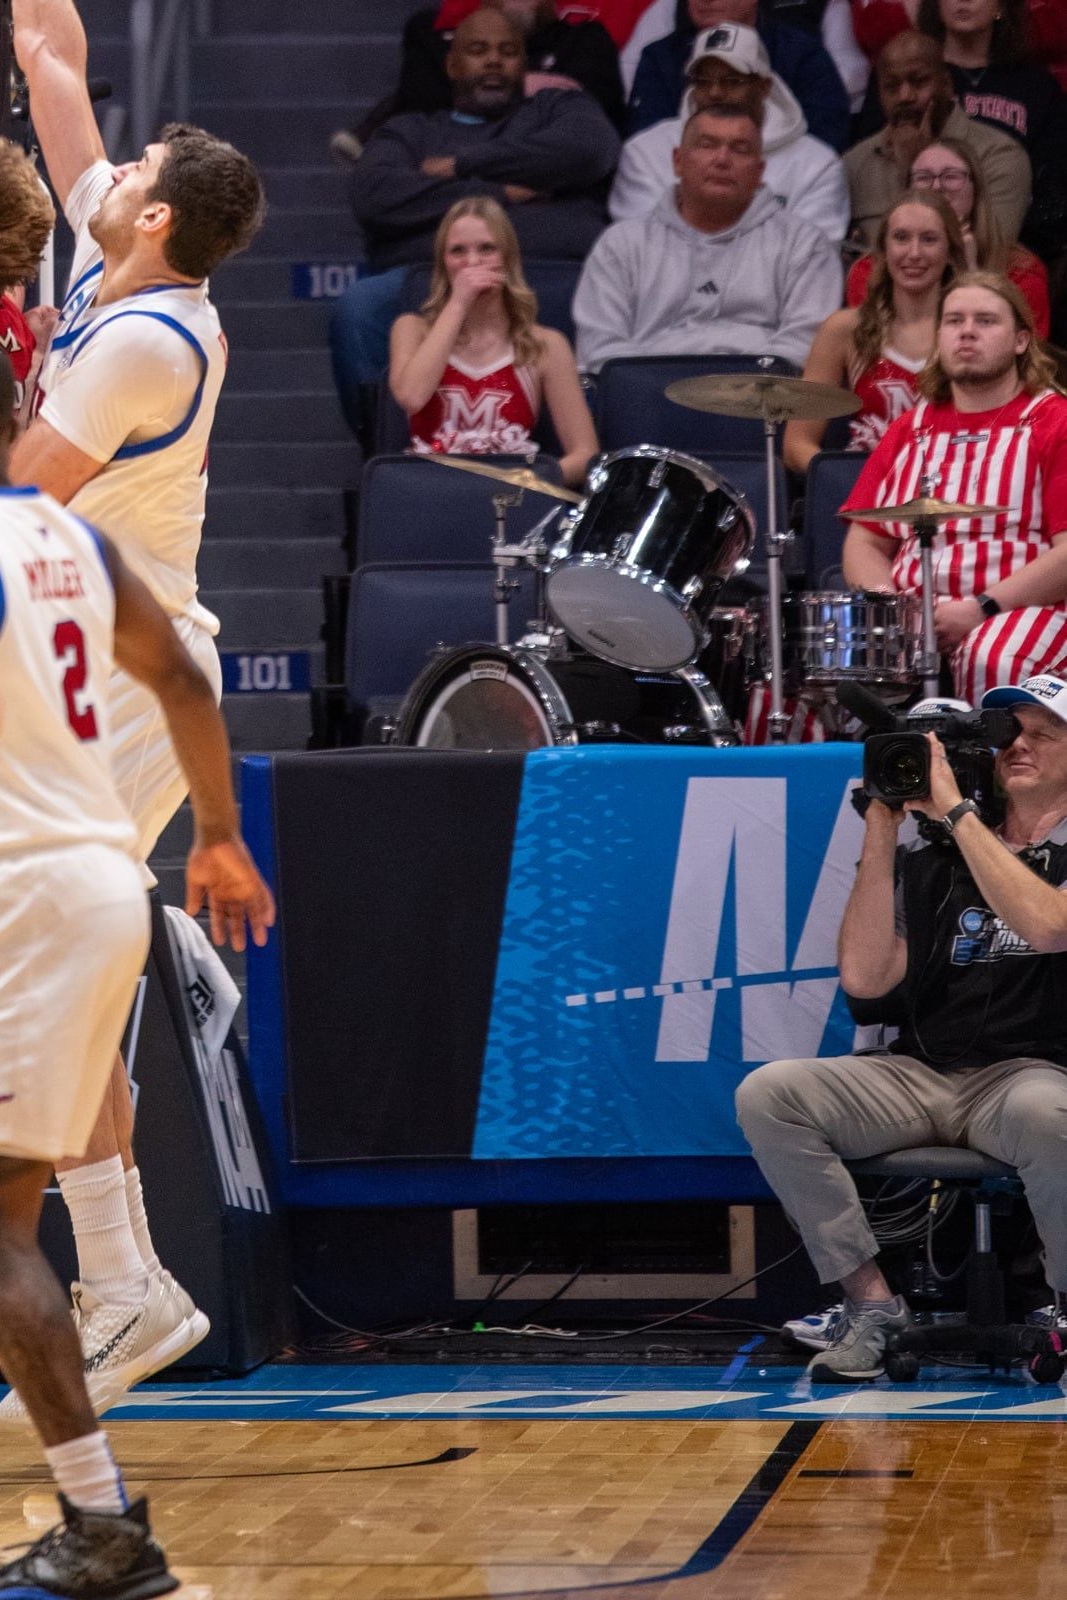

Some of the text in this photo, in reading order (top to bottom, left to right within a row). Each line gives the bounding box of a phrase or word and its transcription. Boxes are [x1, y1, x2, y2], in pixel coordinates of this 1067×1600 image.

[308, 264, 357, 298] 101
[52, 619, 100, 744] 2
[237, 654, 293, 691] 101
